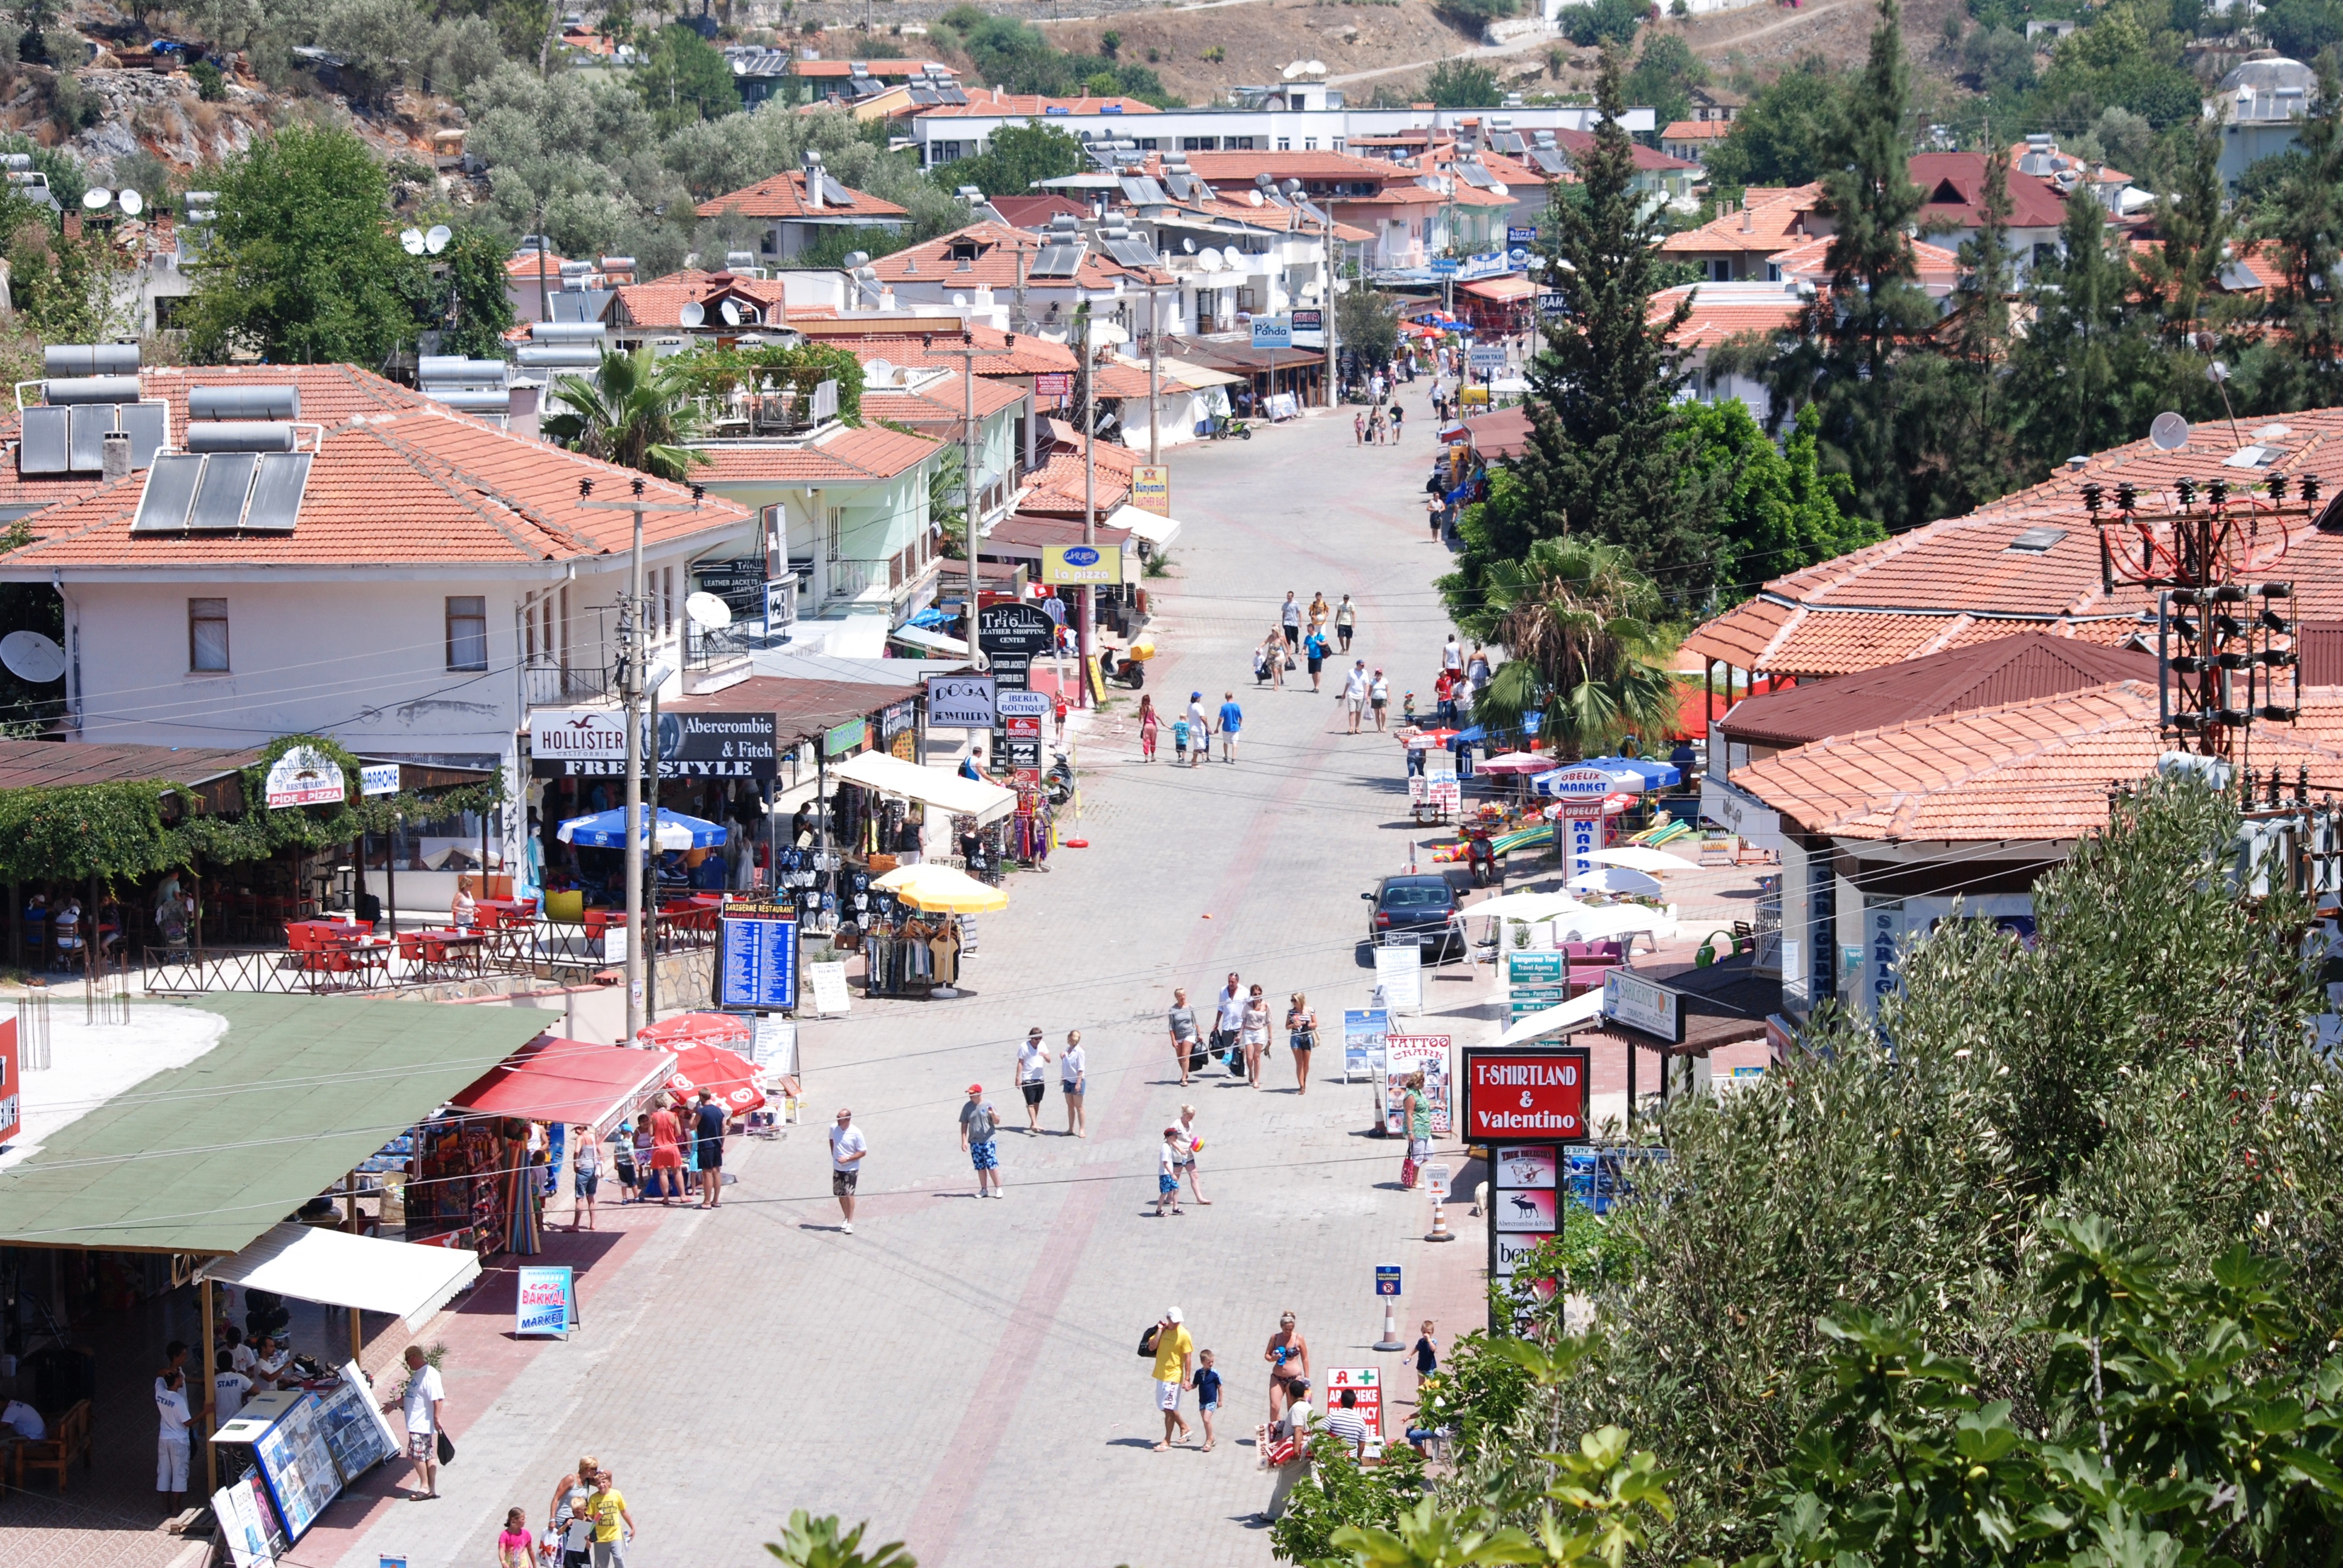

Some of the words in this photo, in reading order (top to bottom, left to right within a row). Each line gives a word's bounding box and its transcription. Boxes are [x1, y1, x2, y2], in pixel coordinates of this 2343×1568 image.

[1255, 323, 1286, 336] Panda
[1136, 497, 1155, 507] LEATHER
[1156, 497, 1165, 507] BAG
[1073, 567, 1109, 583] pizza
[934, 711, 991, 721] JEWELLERY
[684, 717, 773, 733] Abercrombie
[542, 731, 624, 750] HOLLISTER
[722, 741, 734, 757] &
[738, 741, 773, 757] Fitch
[657, 761, 752, 776] STYLE
[362, 769, 398, 790] KARAOKE
[1562, 772, 1600, 781] OBELIX
[286, 780, 327, 791] RESTAURANT
[1559, 783, 1607, 792] MARKET
[1565, 806, 1601, 815] OBELIX
[725, 904, 756, 912] SARIGERME
[758, 904, 795, 913] RESTAURANT
[1869, 897, 1901, 909] Boutique
[1620, 979, 1653, 1008] SARIGERME
[1654, 991, 1673, 1015] TOUR
[1627, 1008, 1645, 1021] TRAVEL
[1646, 1015, 1666, 1028] AGENCY
[1388, 1037, 1449, 1048] TATTOO
[1476, 1064, 1577, 1086] T-SHIRTLAND
[1519, 1091, 1533, 1108] &
[1478, 1110, 1575, 1129] Valentino
[1501, 1151, 1519, 1161] TRUE
[1521, 1150, 1552, 1159] RELIGION
[522, 1289, 566, 1305] BAKKAL
[521, 1312, 563, 1329] MARKET
[217, 1379, 239, 1388] STAFF
[1329, 1390, 1377, 1402] APHEKE
